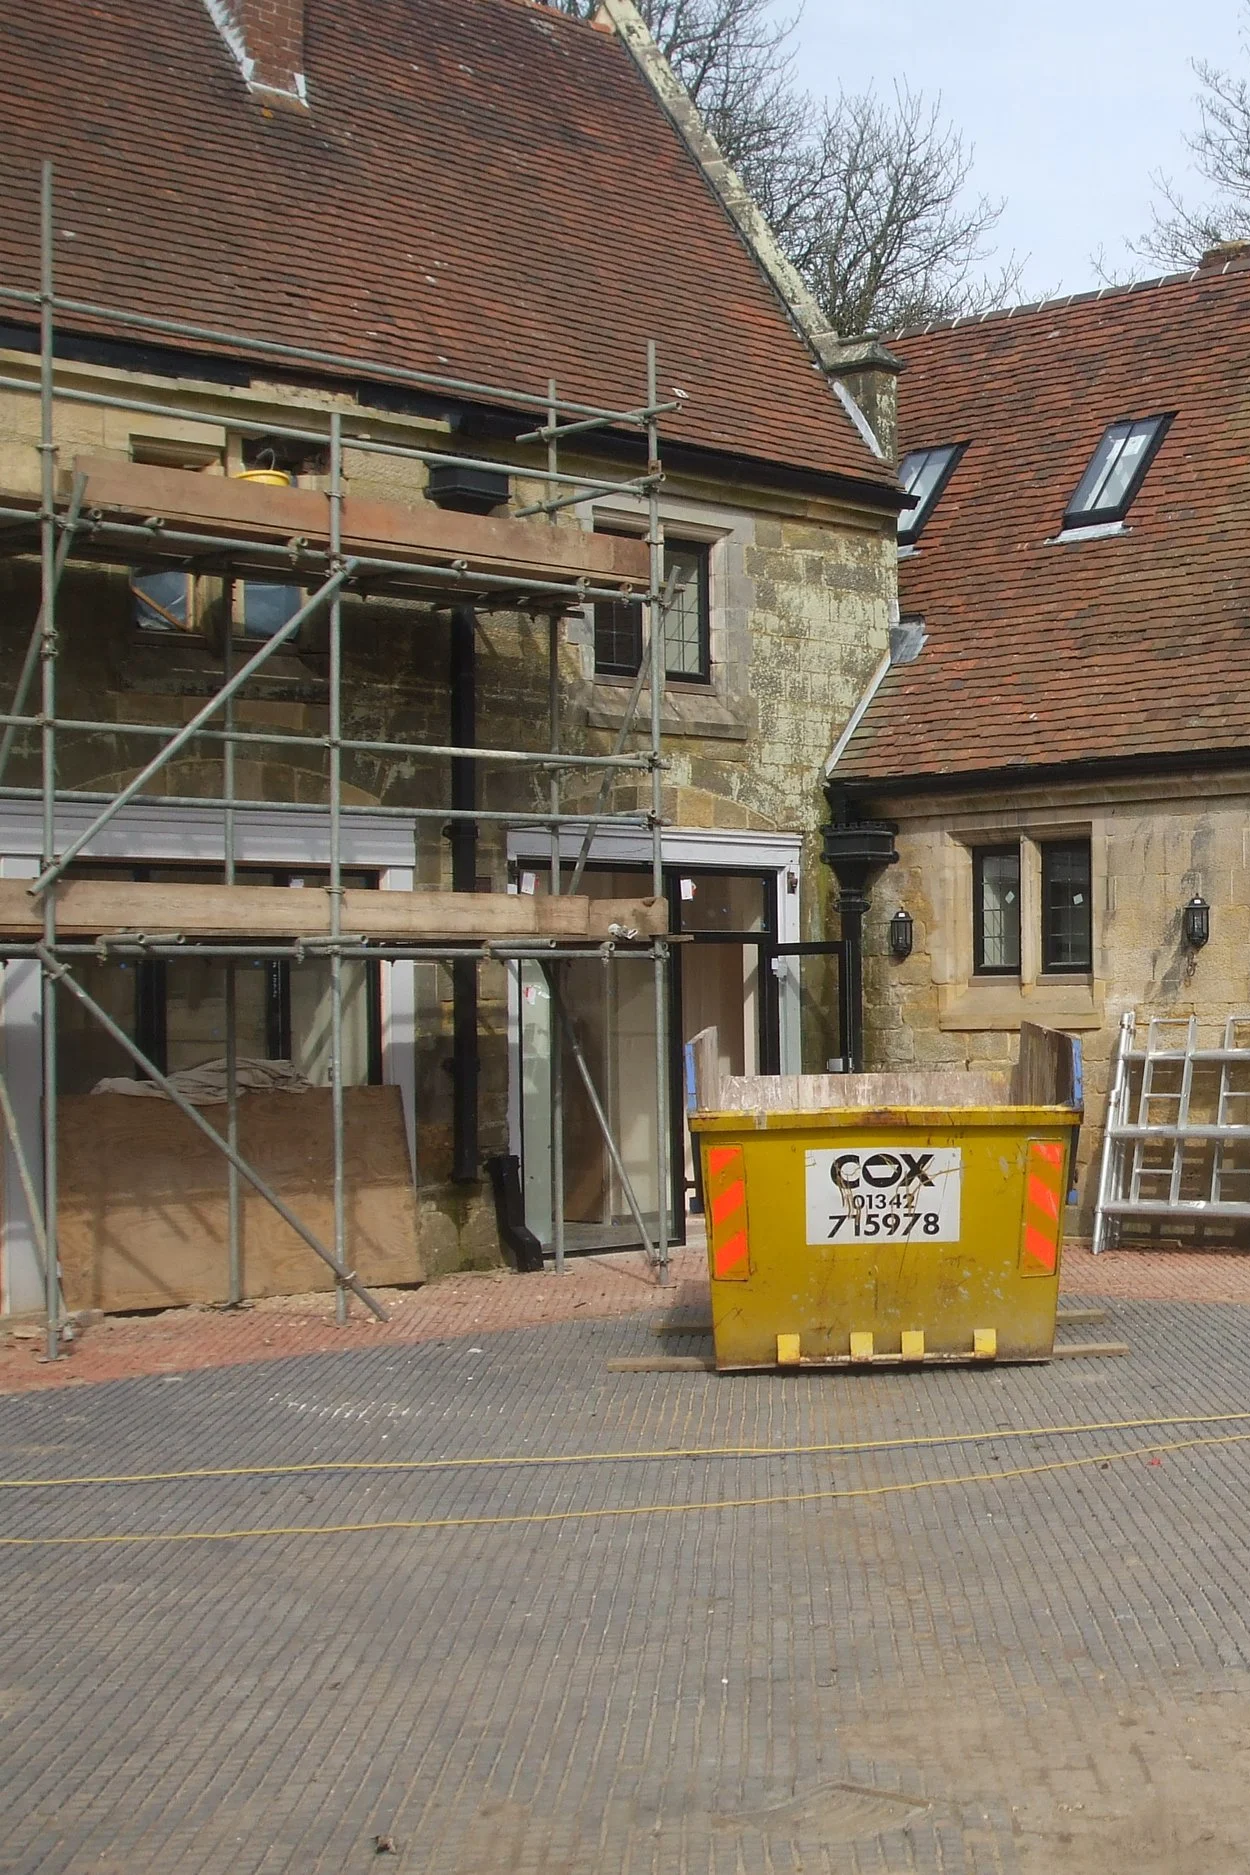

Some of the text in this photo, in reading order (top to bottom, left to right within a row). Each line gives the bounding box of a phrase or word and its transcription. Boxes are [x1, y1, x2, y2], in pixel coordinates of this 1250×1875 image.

[830, 1153, 935, 1189] COX
[853, 1193, 915, 1210] 01342
[827, 1212, 940, 1239] 715978
